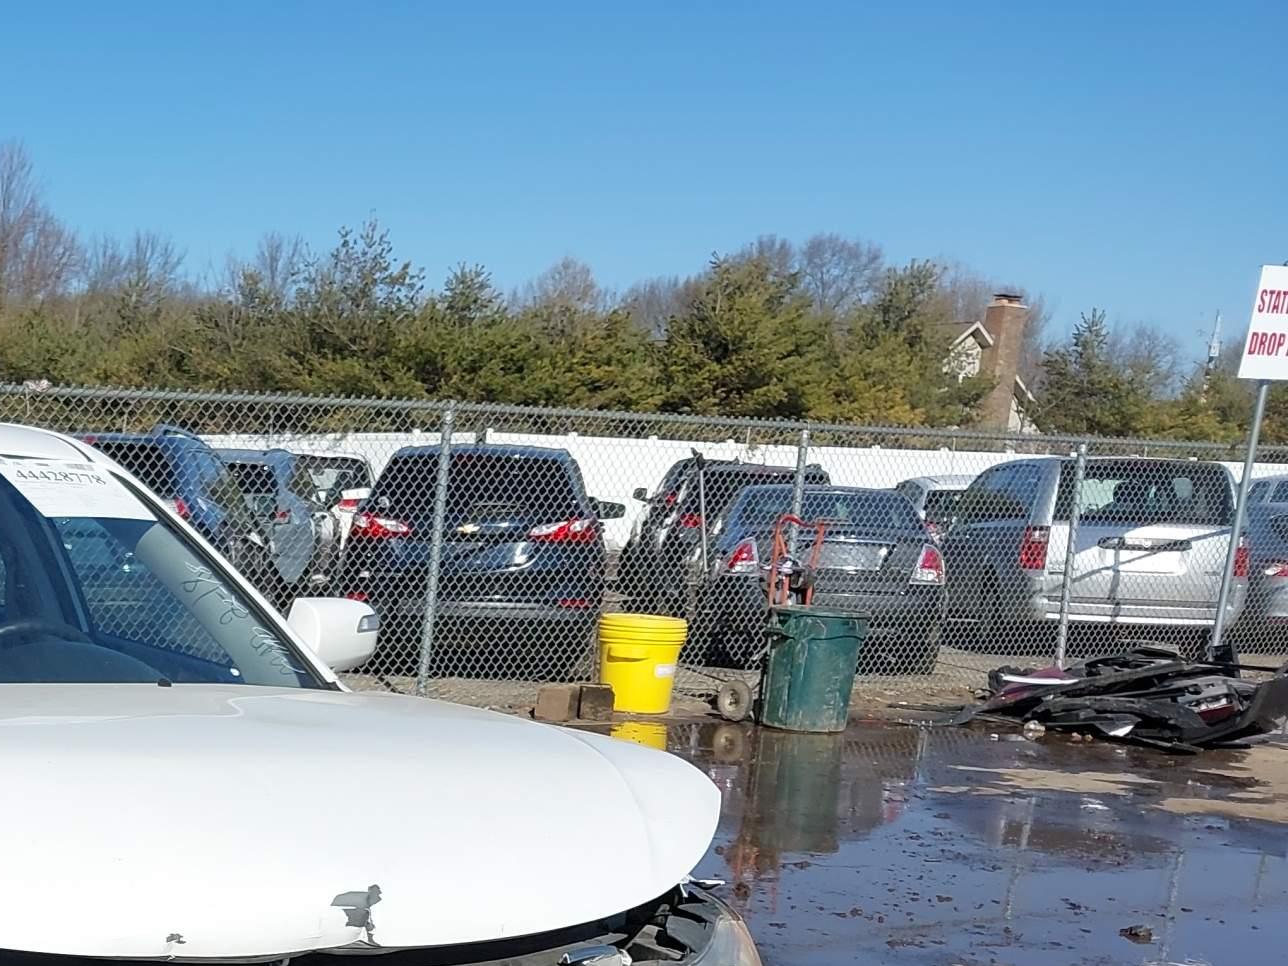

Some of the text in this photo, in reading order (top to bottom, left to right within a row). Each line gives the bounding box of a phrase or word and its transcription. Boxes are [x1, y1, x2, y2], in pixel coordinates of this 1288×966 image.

[1258, 289, 1288, 314] STAT
[1247, 332, 1285, 356] DROP
[16, 469, 106, 485] 44428778
